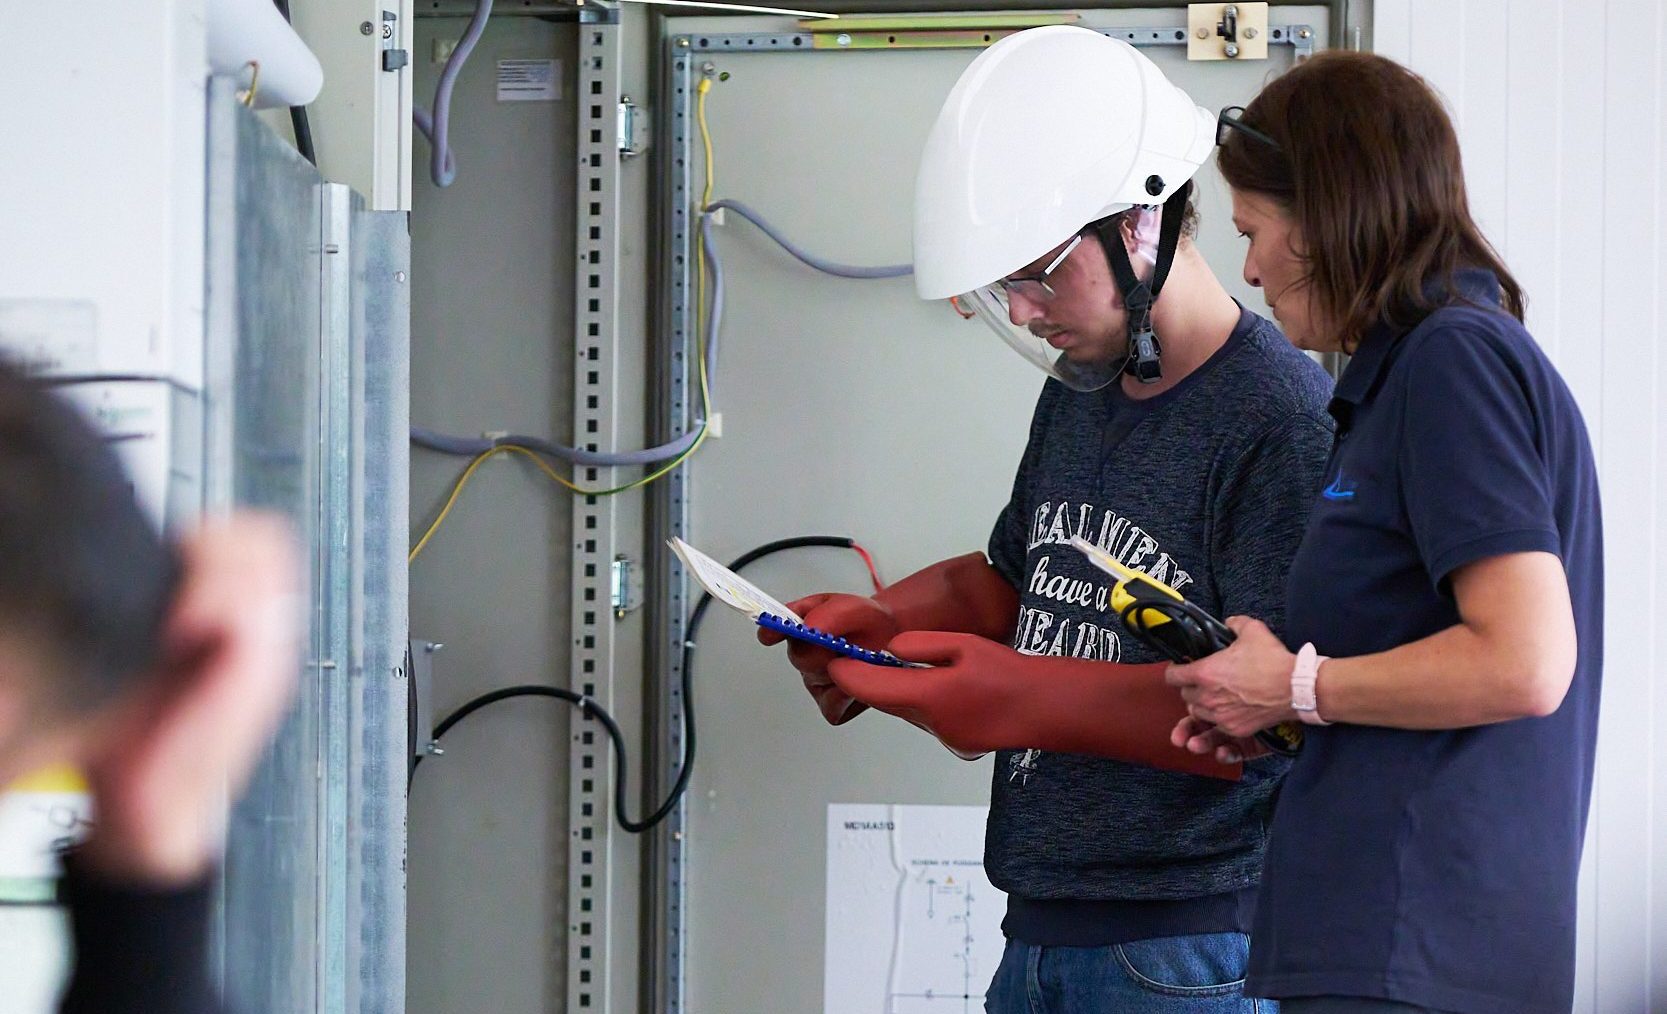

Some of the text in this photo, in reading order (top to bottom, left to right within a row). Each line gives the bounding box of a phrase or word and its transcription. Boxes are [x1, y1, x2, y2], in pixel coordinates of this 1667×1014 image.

[1028, 501, 1194, 591] EAL MEN
[1029, 556, 1108, 612] have a
